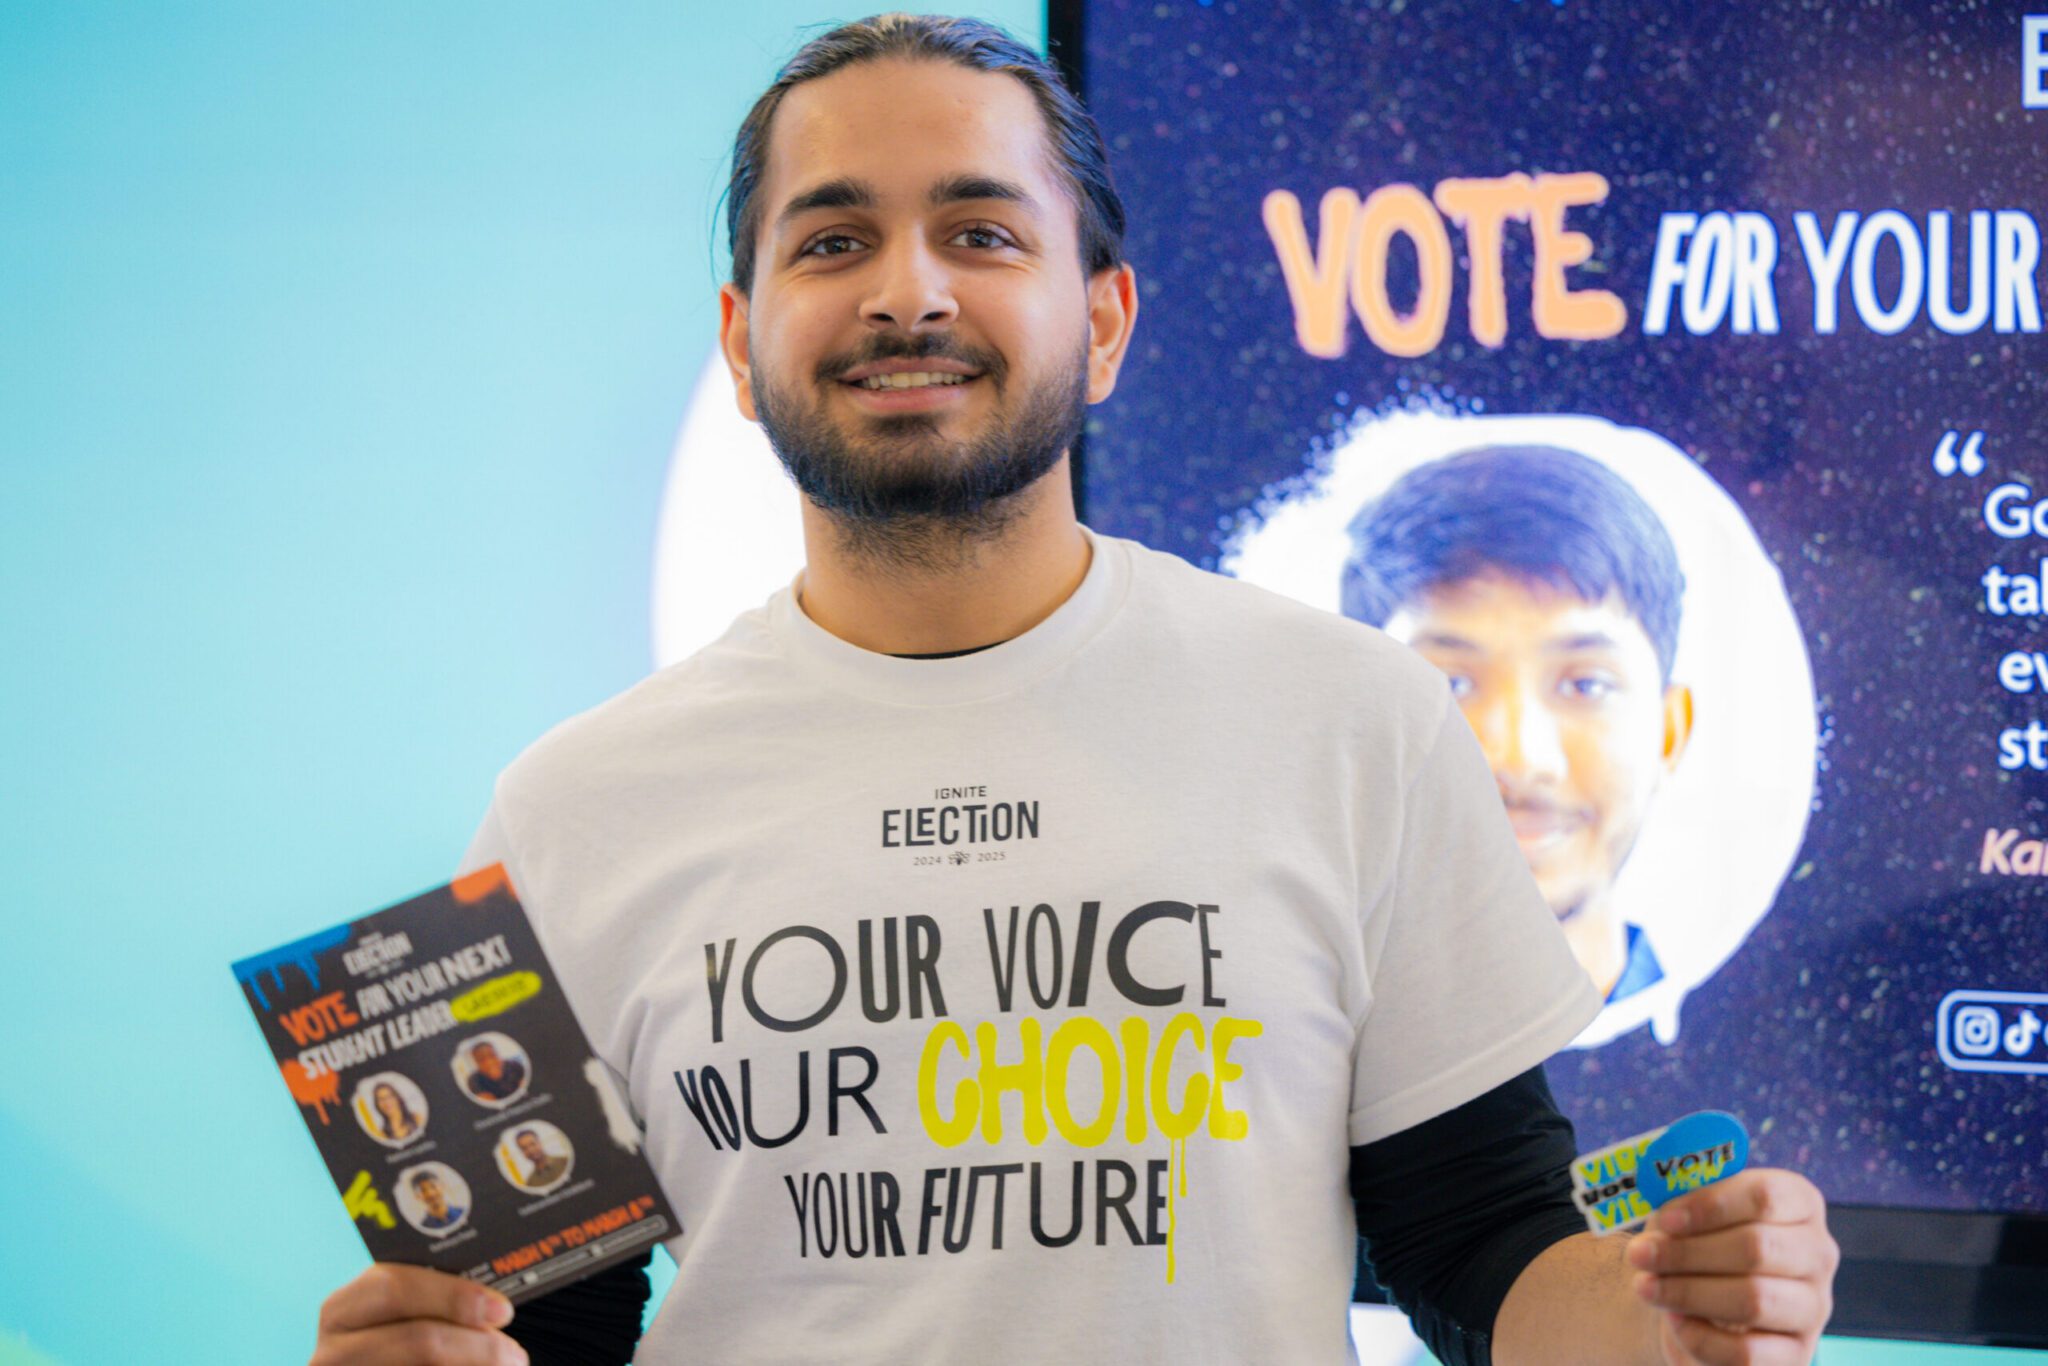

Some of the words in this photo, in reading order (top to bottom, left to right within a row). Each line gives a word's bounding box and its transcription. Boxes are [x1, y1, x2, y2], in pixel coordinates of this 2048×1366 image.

[1263, 172, 1626, 358] VOTE
[1642, 210, 1780, 336] FOR
[1795, 209, 2043, 336] YOUR
[882, 800, 1039, 848] ELECTION
[935, 785, 987, 800] IGNITE
[913, 855, 942, 866] 2024
[977, 851, 1006, 863] 2025
[278, 990, 360, 1048] VOTE
[384, 960, 449, 1007] YOUR
[439, 934, 513, 987] NEXT
[704, 914, 948, 1043] YOUR
[983, 900, 1226, 1013] VOICE
[673, 1046, 888, 1152] YOUR
[917, 1012, 1264, 1152] CHOICE
[784, 1170, 906, 1259] YOUR
[917, 1158, 1169, 1256] FUTURE
[1655, 1141, 1735, 1179] VOTE
